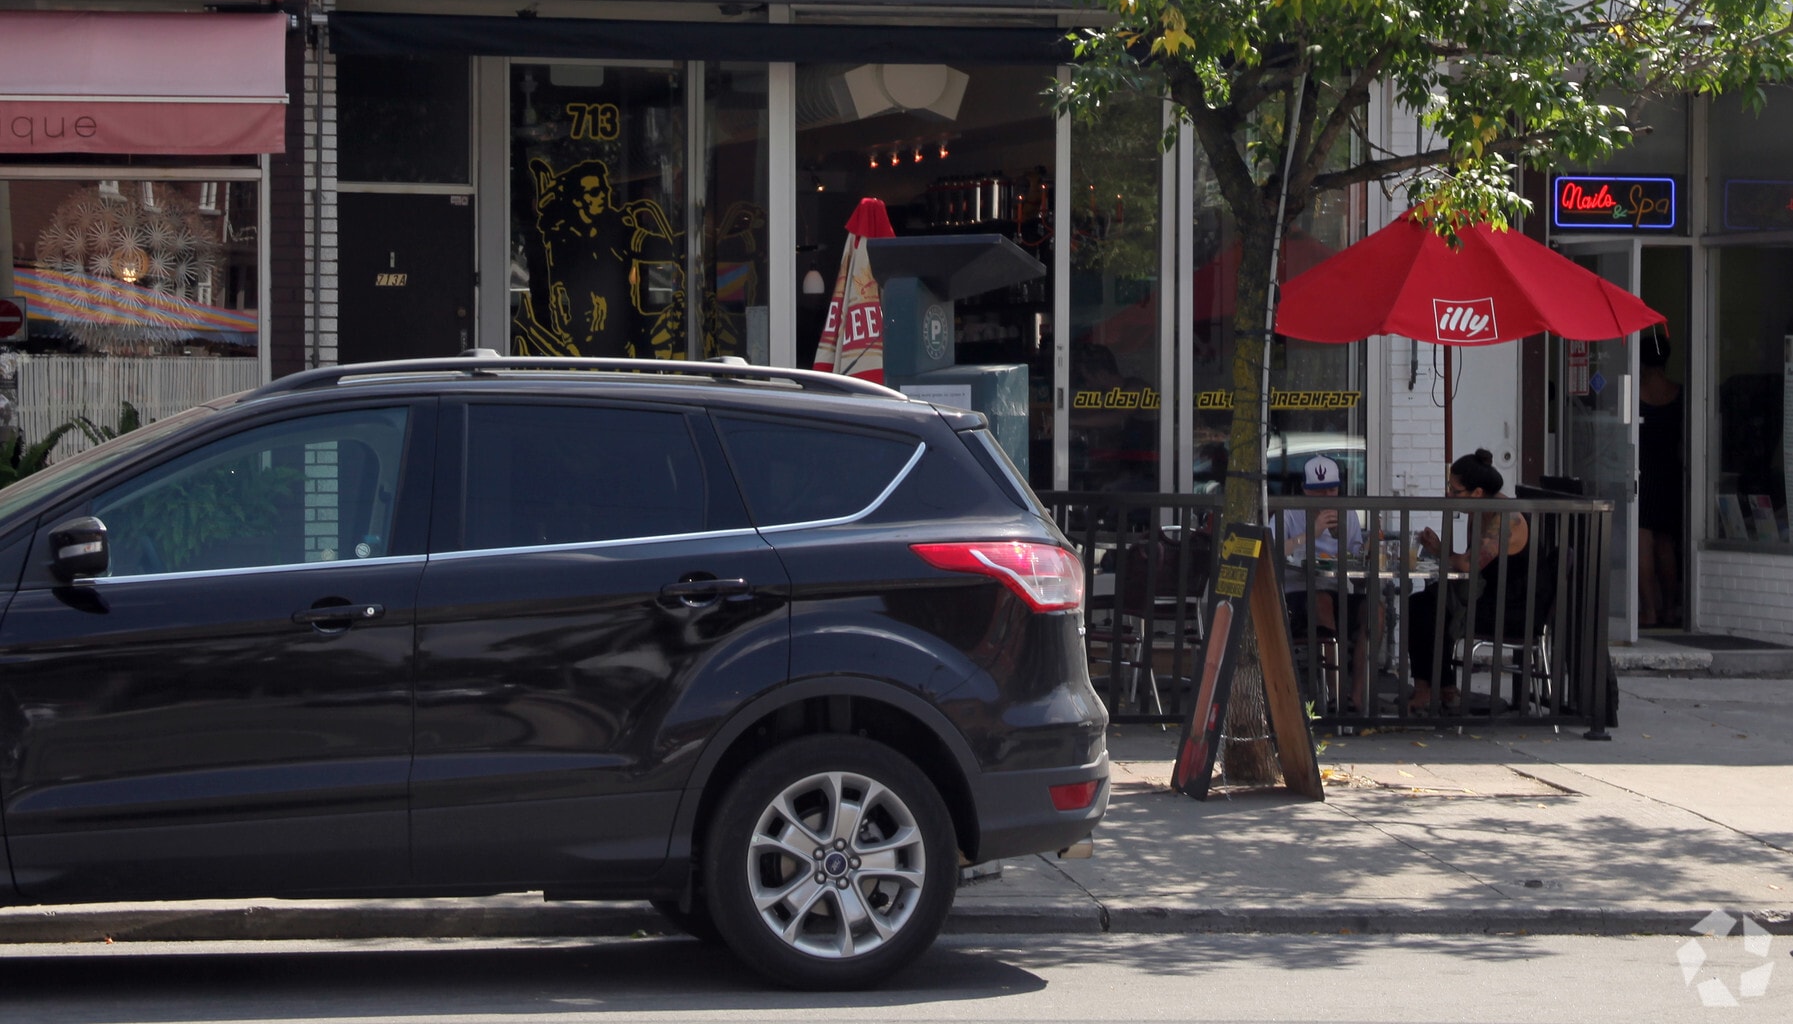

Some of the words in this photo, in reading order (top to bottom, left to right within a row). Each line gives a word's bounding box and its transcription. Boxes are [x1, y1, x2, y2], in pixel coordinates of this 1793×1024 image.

[10, 115, 98, 144] que
[567, 103, 620, 140] 713
[1562, 182, 1616, 210] Nails
[1627, 184, 1669, 227] Spa
[1440, 306, 1489, 337] illy
[1074, 392, 1101, 408] all
[1104, 387, 1139, 408] day
